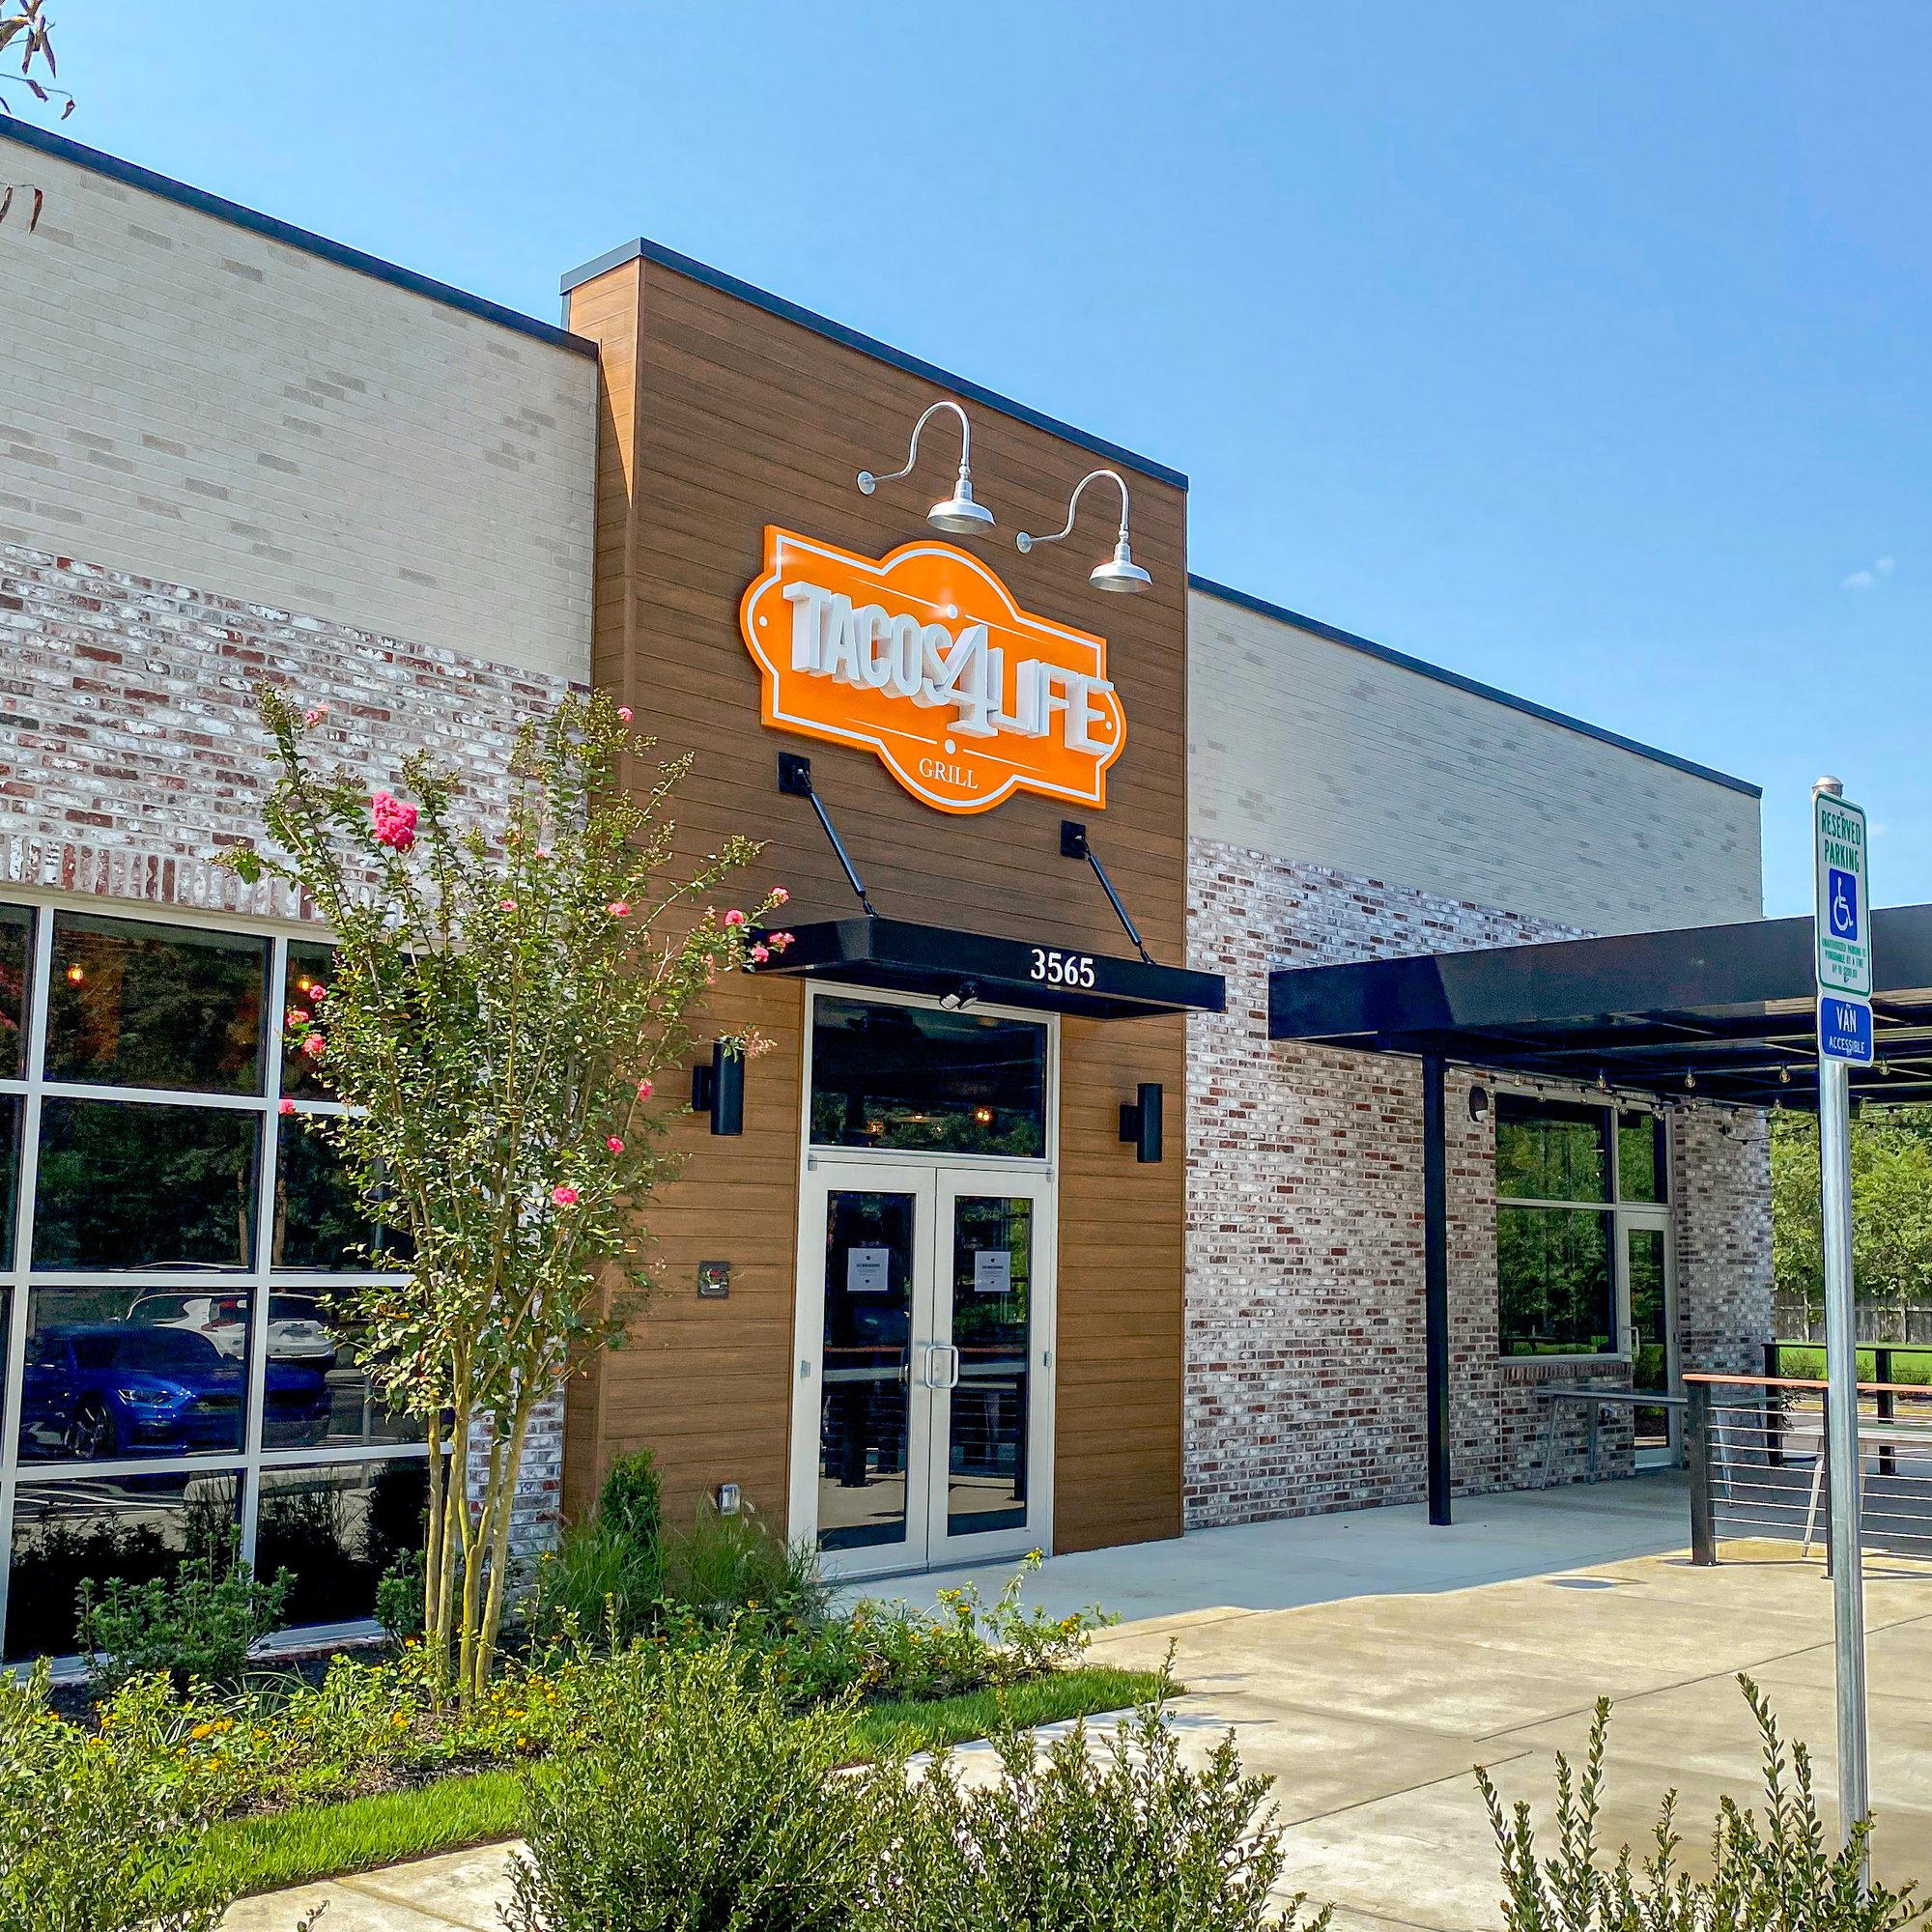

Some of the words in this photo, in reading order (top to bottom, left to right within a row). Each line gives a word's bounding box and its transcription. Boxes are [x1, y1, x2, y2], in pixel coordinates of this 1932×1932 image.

[919, 757, 979, 789] GRILL
[1821, 810, 1861, 845] RESERVED
[1824, 838, 1860, 872] PARKING
[1030, 949, 1095, 987] 3565
[1836, 1006, 1857, 1033] VAN
[1829, 1036, 1865, 1055] ACCESSIBLE
